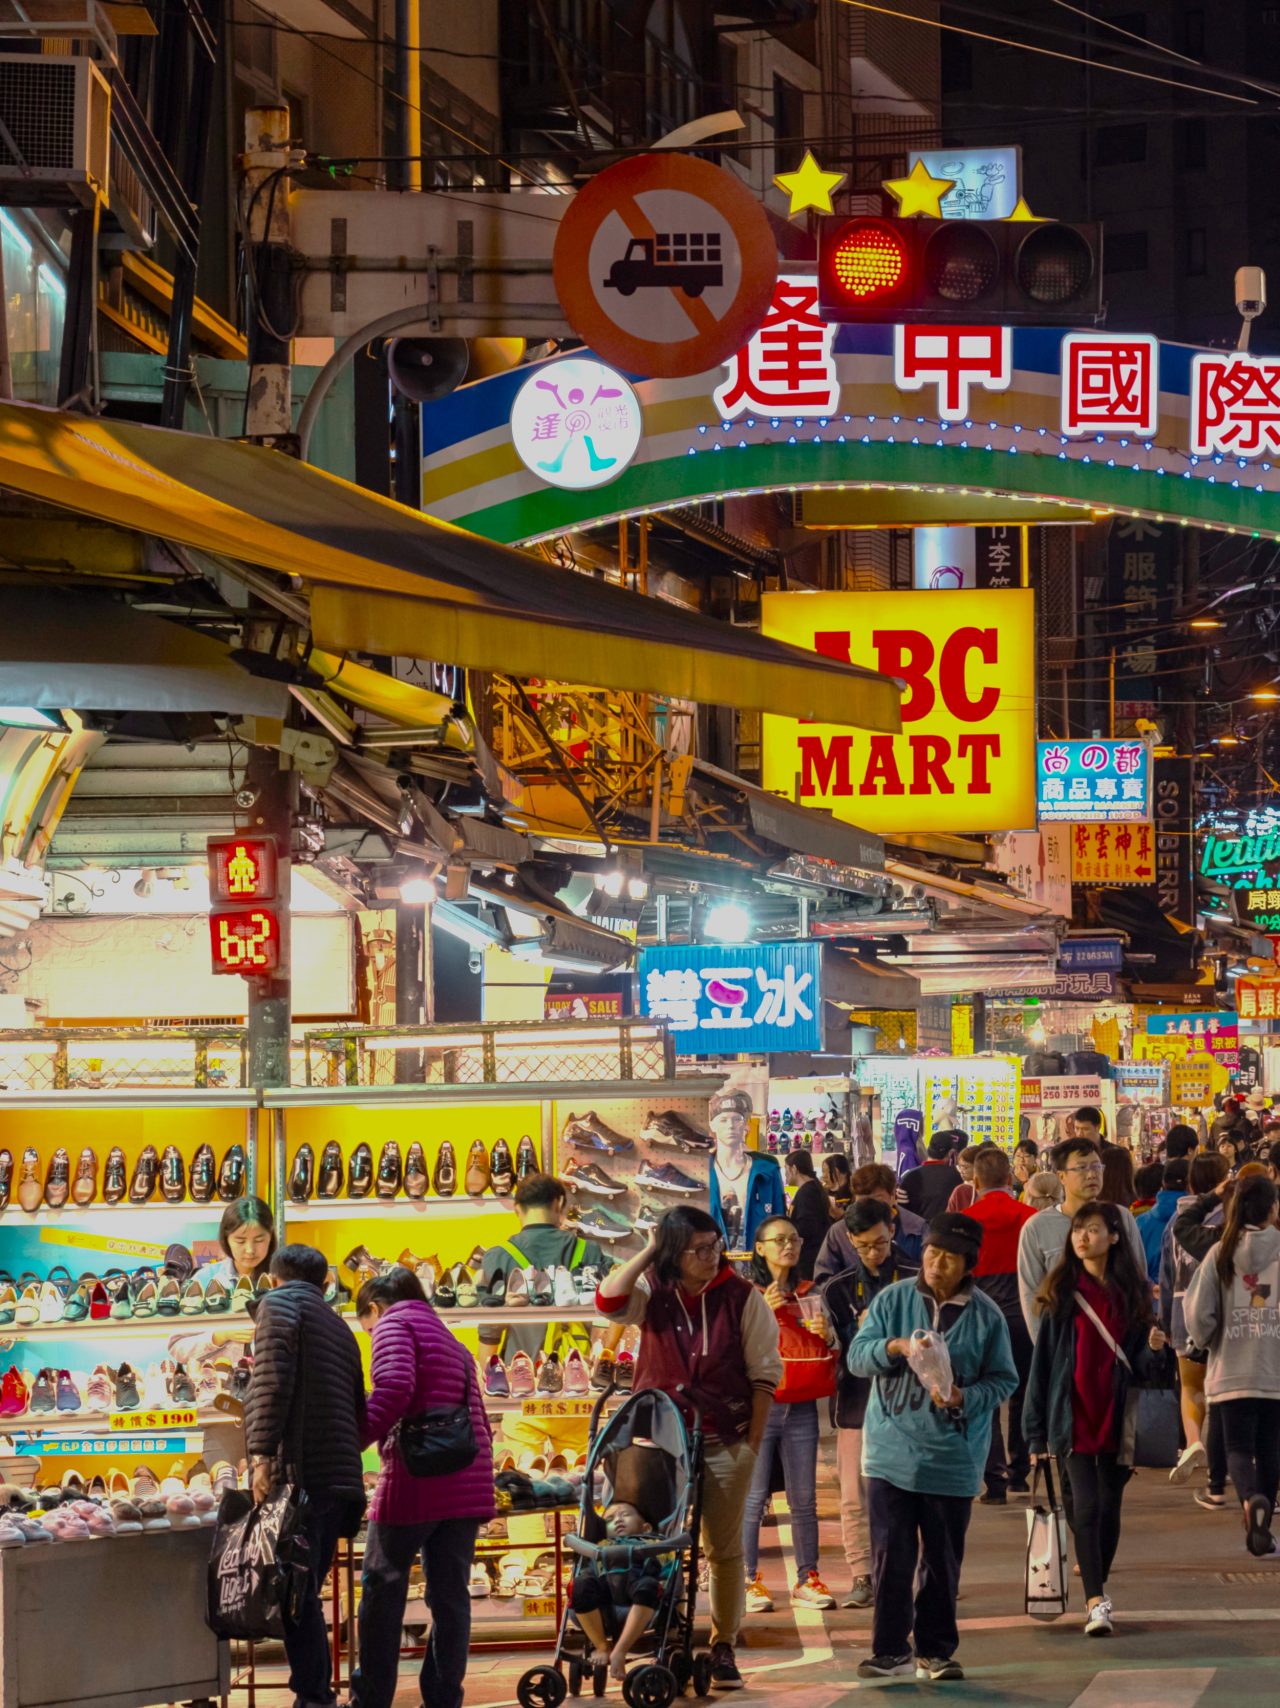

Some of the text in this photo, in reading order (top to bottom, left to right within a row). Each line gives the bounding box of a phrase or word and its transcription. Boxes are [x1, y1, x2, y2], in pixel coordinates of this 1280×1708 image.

[797, 734, 1001, 797] MART
[1043, 744, 1142, 774] 尚の都
[1042, 778, 1144, 801] 商品專賣
[1157, 780, 1180, 913] SOLBERR
[589, 1000, 618, 1014] SALE
[1063, 1090, 1080, 1100] 375
[1083, 1089, 1100, 1098] 500
[556, 1401, 594, 1414] $19
